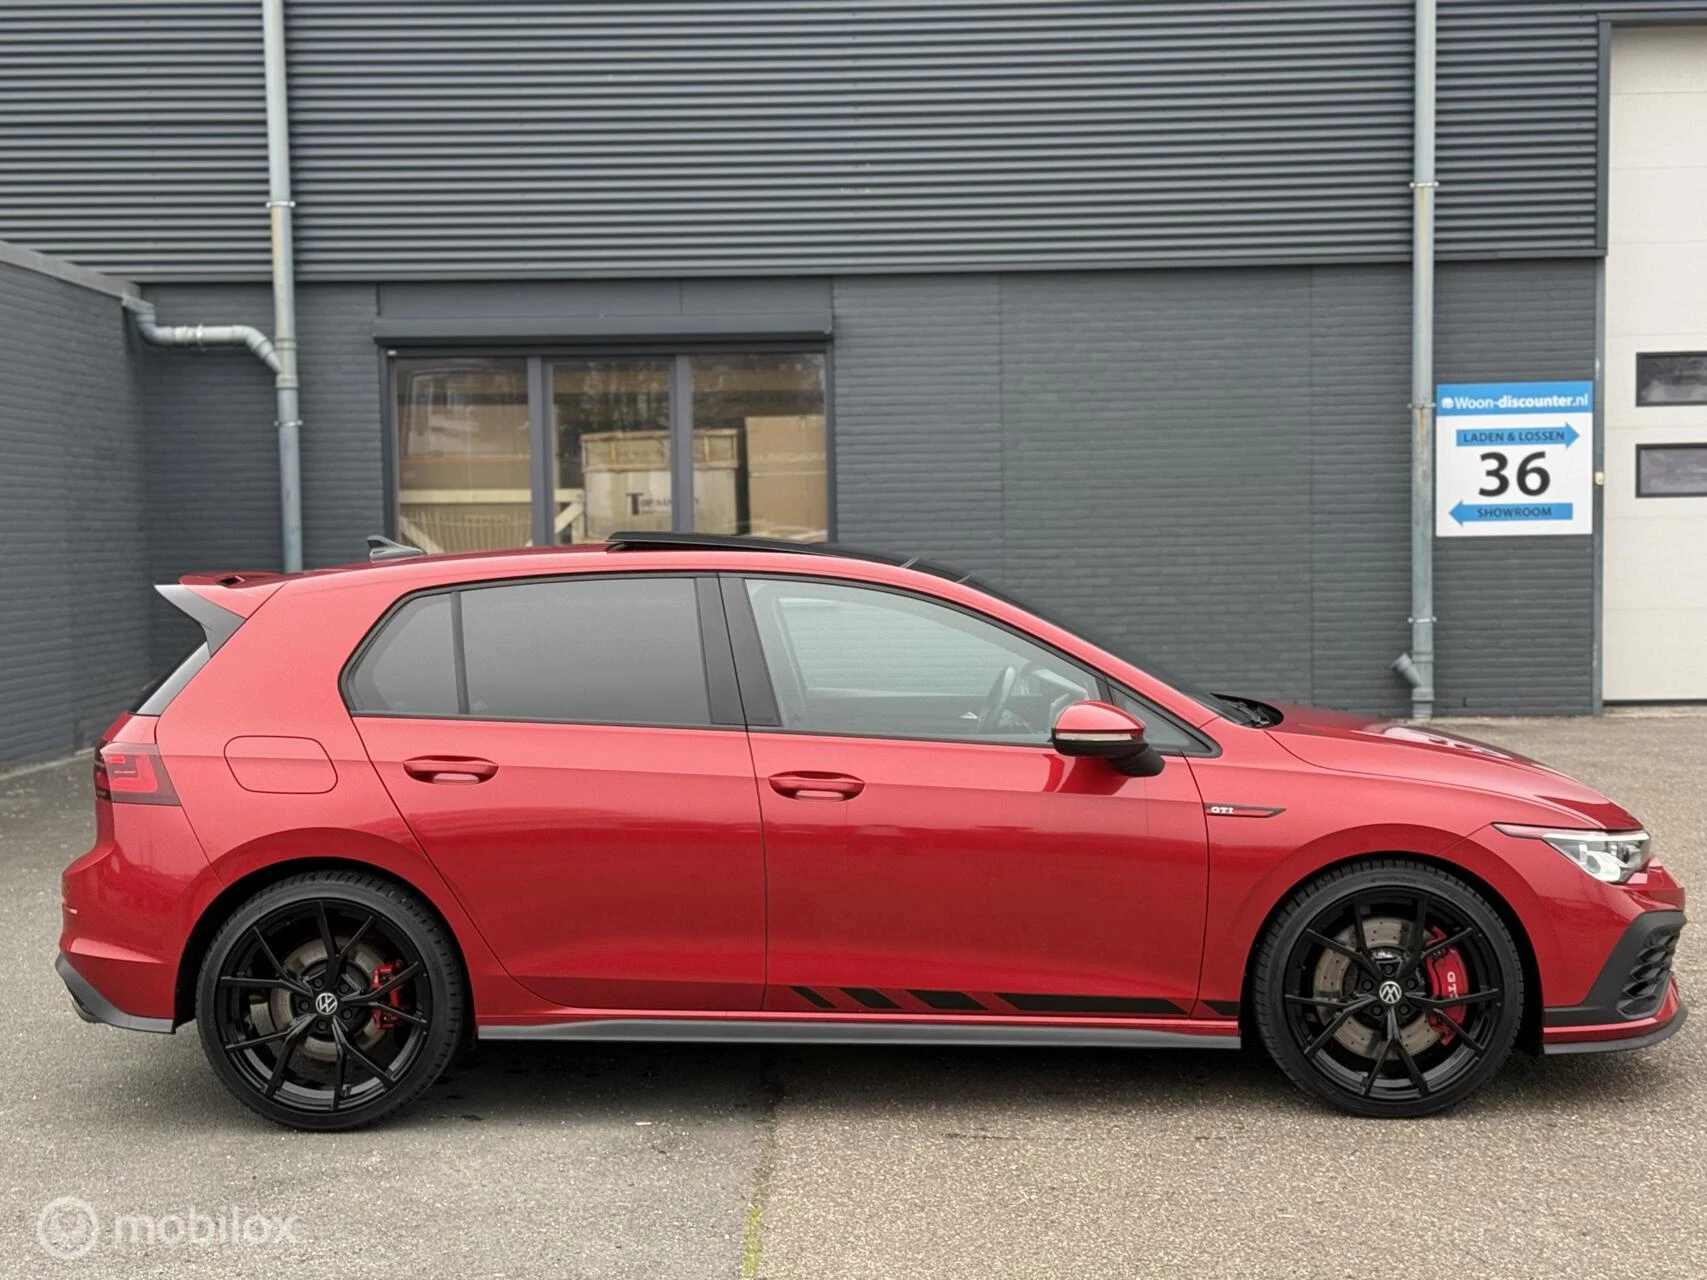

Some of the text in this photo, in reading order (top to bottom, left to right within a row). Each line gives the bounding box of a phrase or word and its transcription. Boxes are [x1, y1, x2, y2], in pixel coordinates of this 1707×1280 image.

[1455, 394, 1589, 409] Woon-discounter.nl
[1463, 430, 1565, 443] LADEN & LOSSEN
[1478, 451, 1551, 497] 36
[1477, 506, 1552, 518] SHOWROOM
[1211, 806, 1234, 814] GTI
